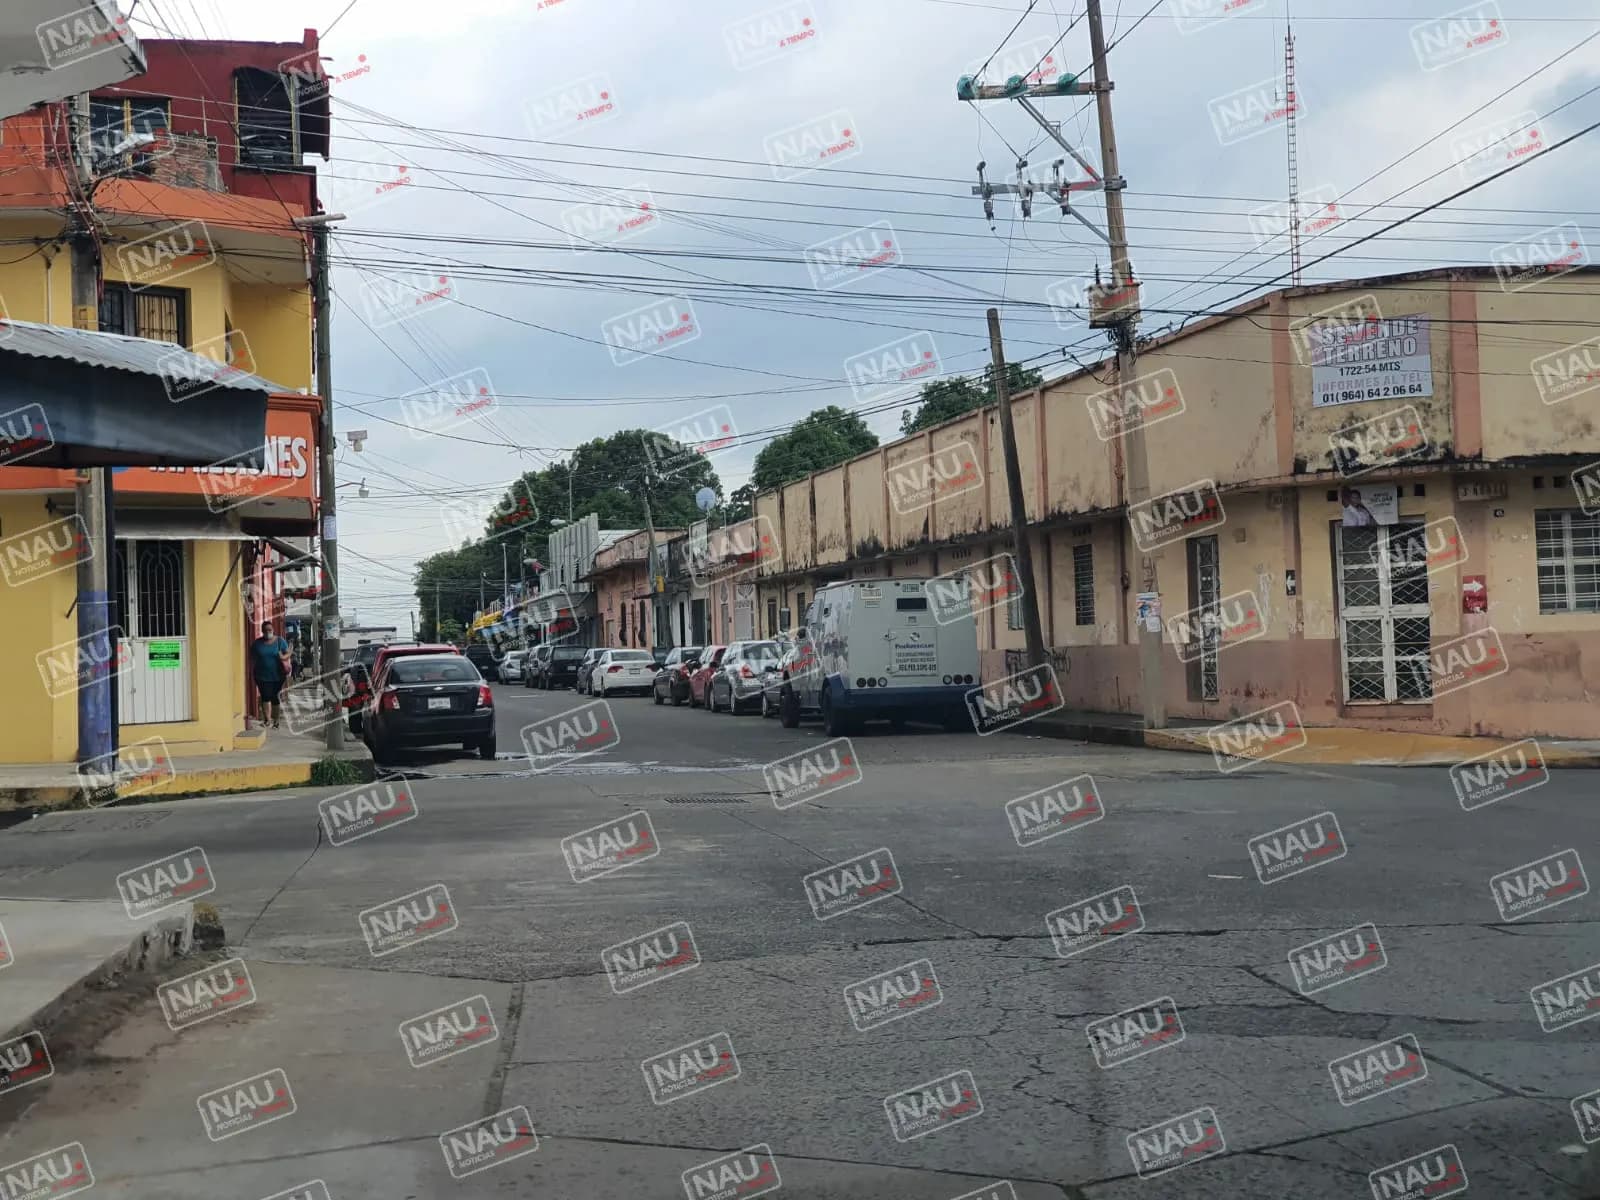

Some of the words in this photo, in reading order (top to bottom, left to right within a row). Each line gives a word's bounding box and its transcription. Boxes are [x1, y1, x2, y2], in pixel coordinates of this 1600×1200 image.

[1346, 319, 1418, 341] VENDE
[1322, 337, 1417, 365] TERRENO
[1318, 377, 1380, 392] INFORMES
[1384, 375, 1399, 386] AL
[1367, 387, 1381, 398] 64
[1383, 387, 1391, 397] 2
[1393, 385, 1407, 396] 06
[1408, 383, 1423, 394] 64
